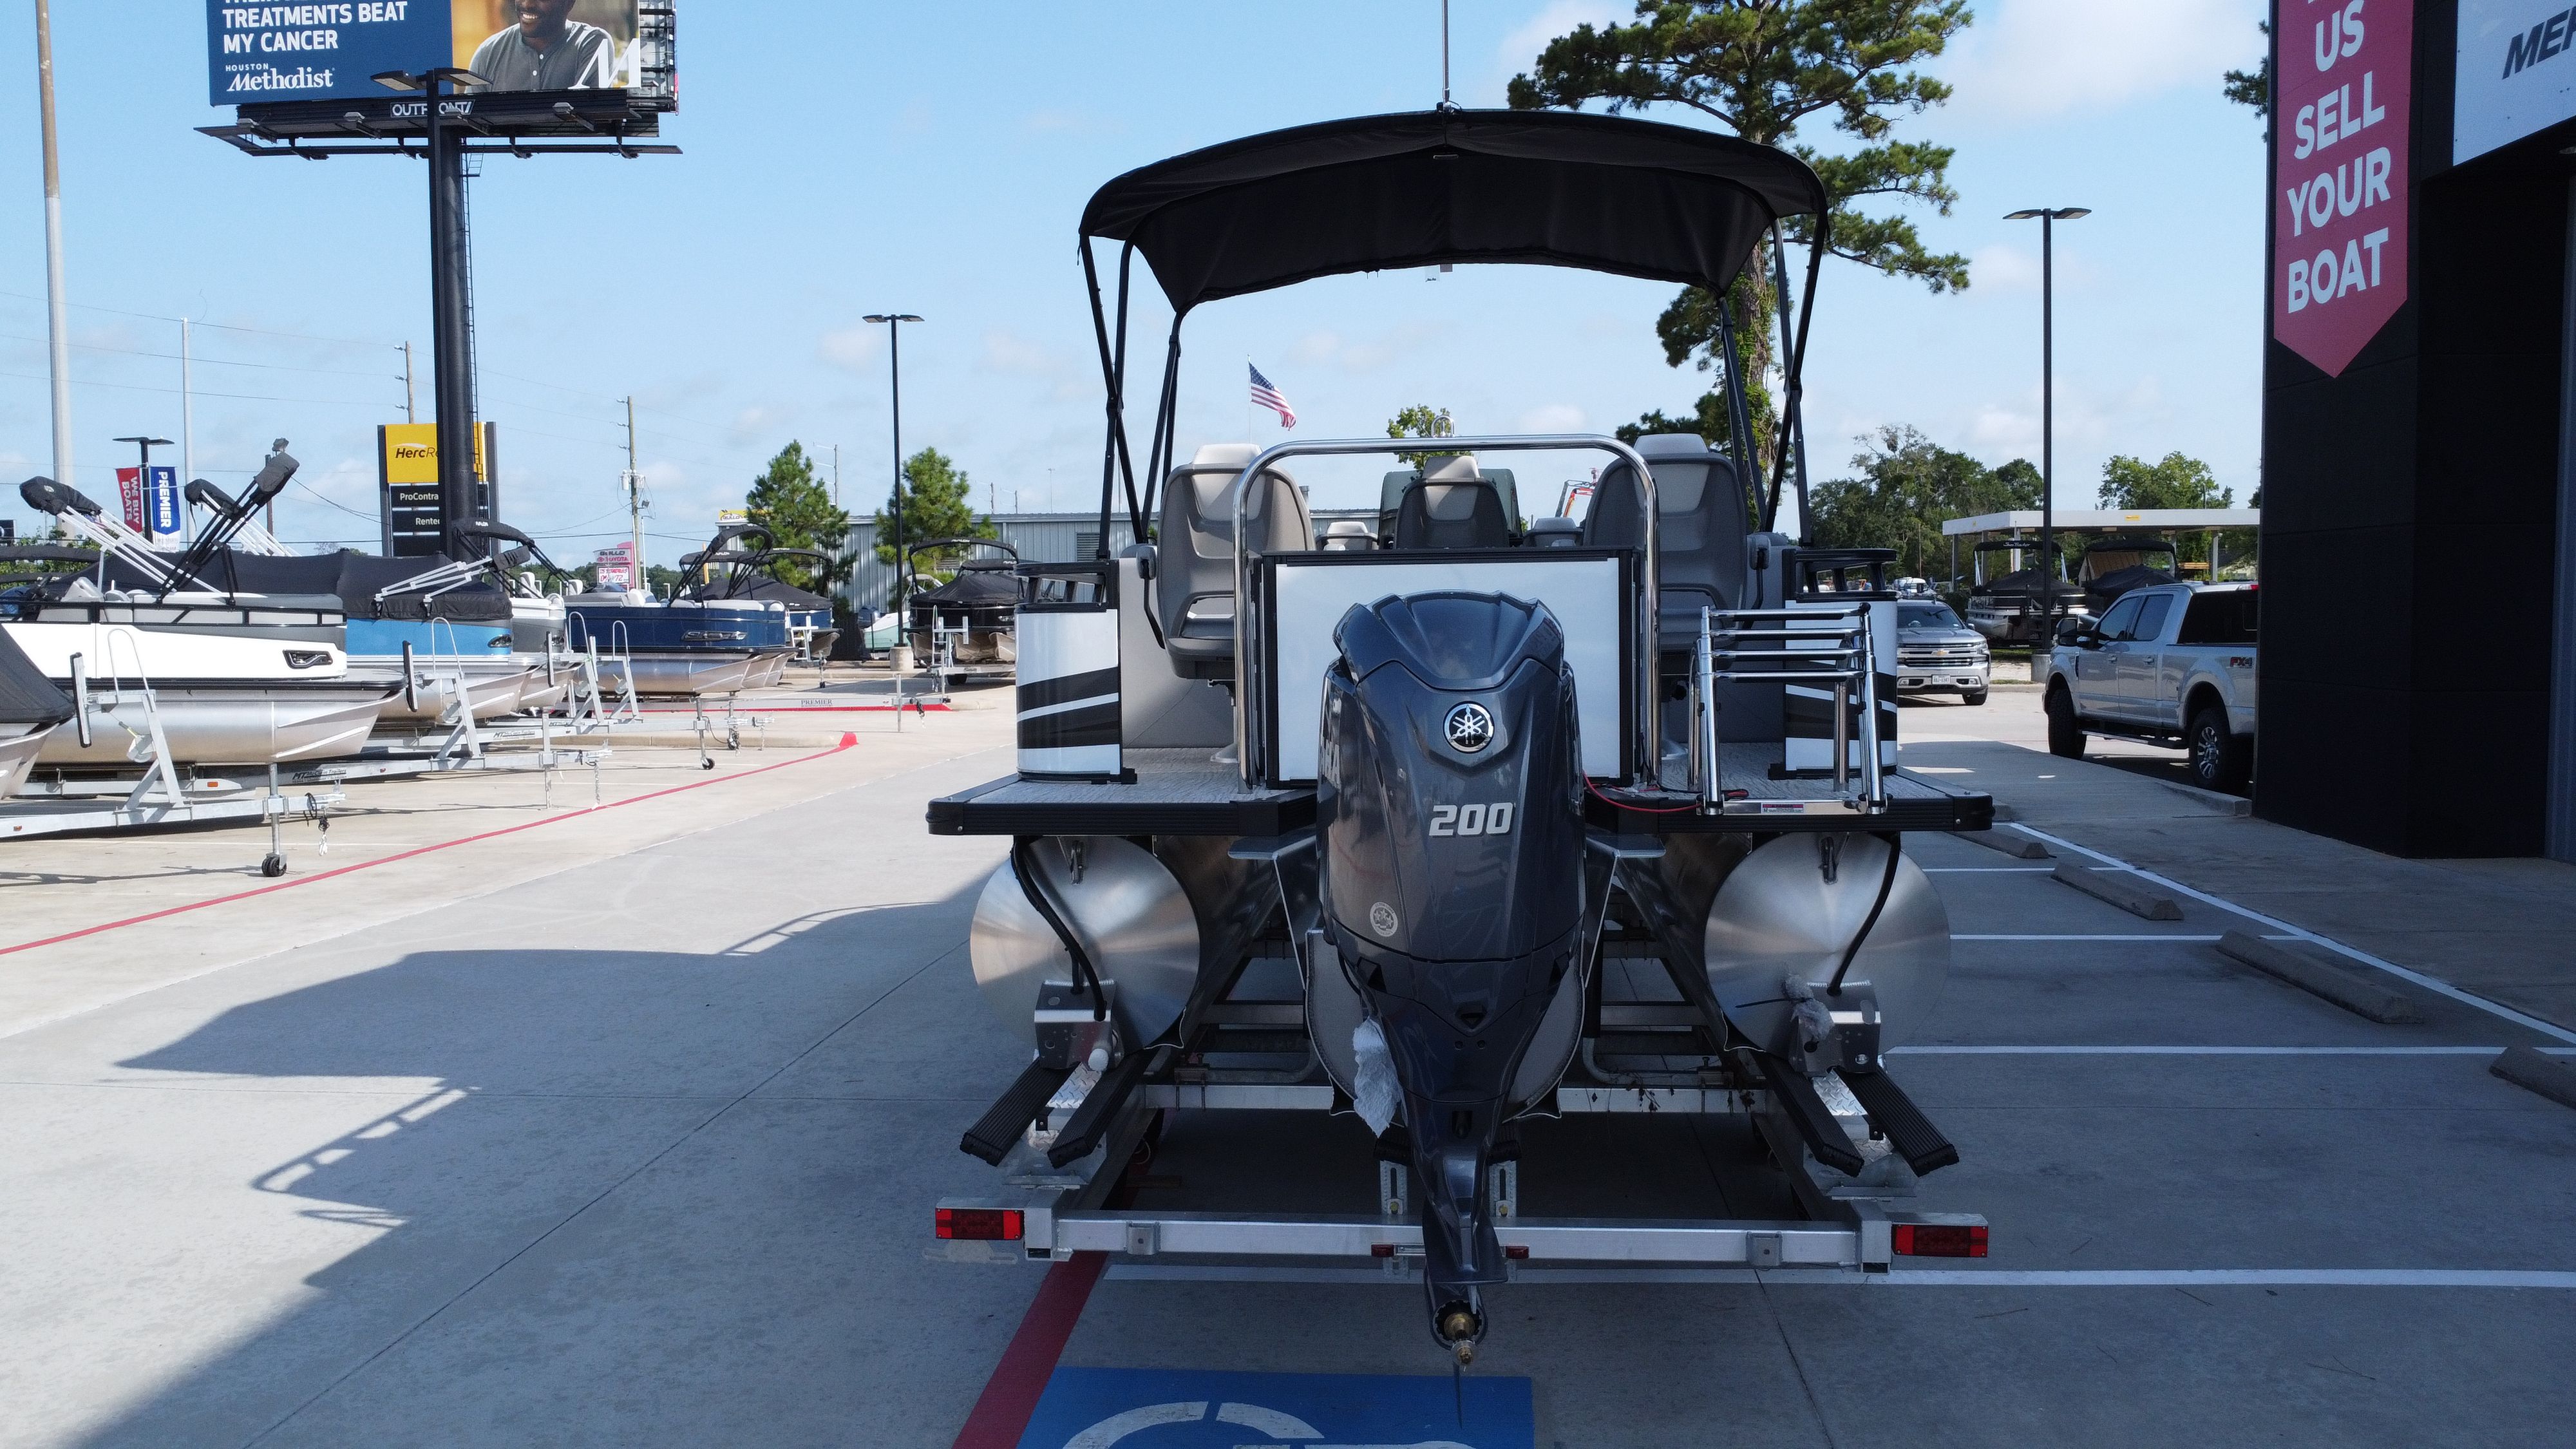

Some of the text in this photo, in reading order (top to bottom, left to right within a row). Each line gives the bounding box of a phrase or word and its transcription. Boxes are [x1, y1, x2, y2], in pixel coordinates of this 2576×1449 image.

[222, 1, 408, 28] TREATMENTS BEAT
[223, 30, 339, 53] MY CANCER
[2315, 0, 2365, 72] US
[225, 63, 269, 71] HOUSTON
[226, 67, 334, 91] Methodist
[2294, 71, 2385, 160] SELL
[2286, 147, 2391, 237] YOUR
[2287, 227, 2389, 314] BOAT
[122, 481, 133, 520] BOATS
[131, 476, 138, 497] WE
[158, 471, 172, 527] PREMIER
[2230, 657, 2253, 668] FX4
[1428, 802, 1514, 836] 200
